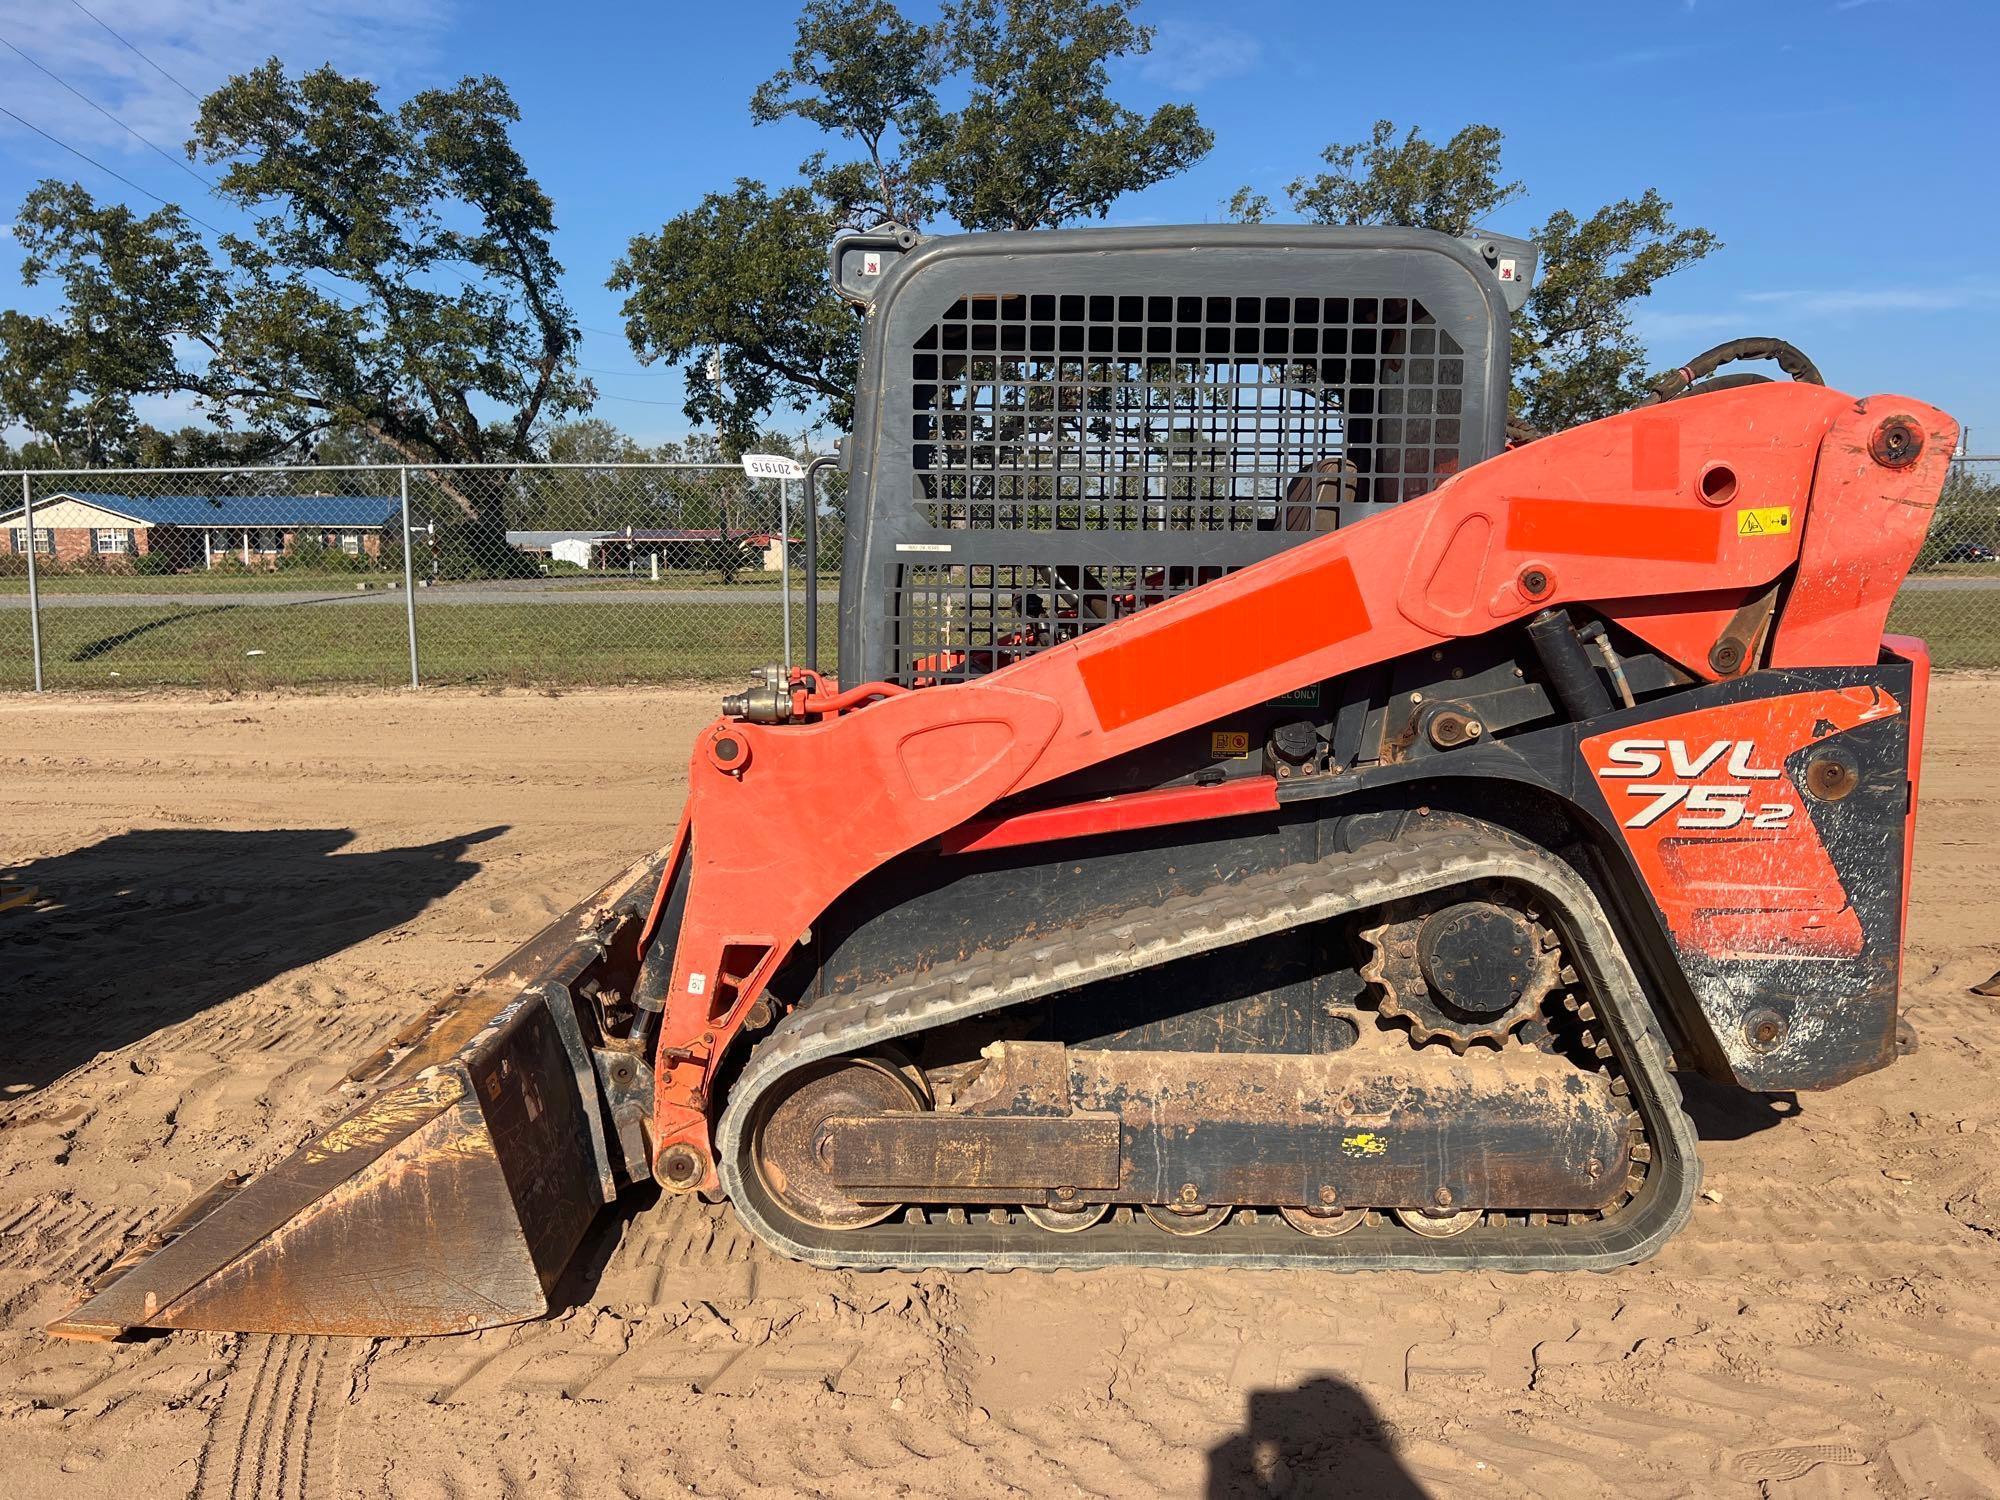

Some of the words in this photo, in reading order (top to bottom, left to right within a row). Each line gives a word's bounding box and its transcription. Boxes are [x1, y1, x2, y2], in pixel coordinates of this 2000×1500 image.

[751, 462, 791, 475] 201915
[1294, 690, 1317, 699] ONLY
[1598, 740, 1782, 779] SVL
[1623, 784, 1795, 829] 75-2
